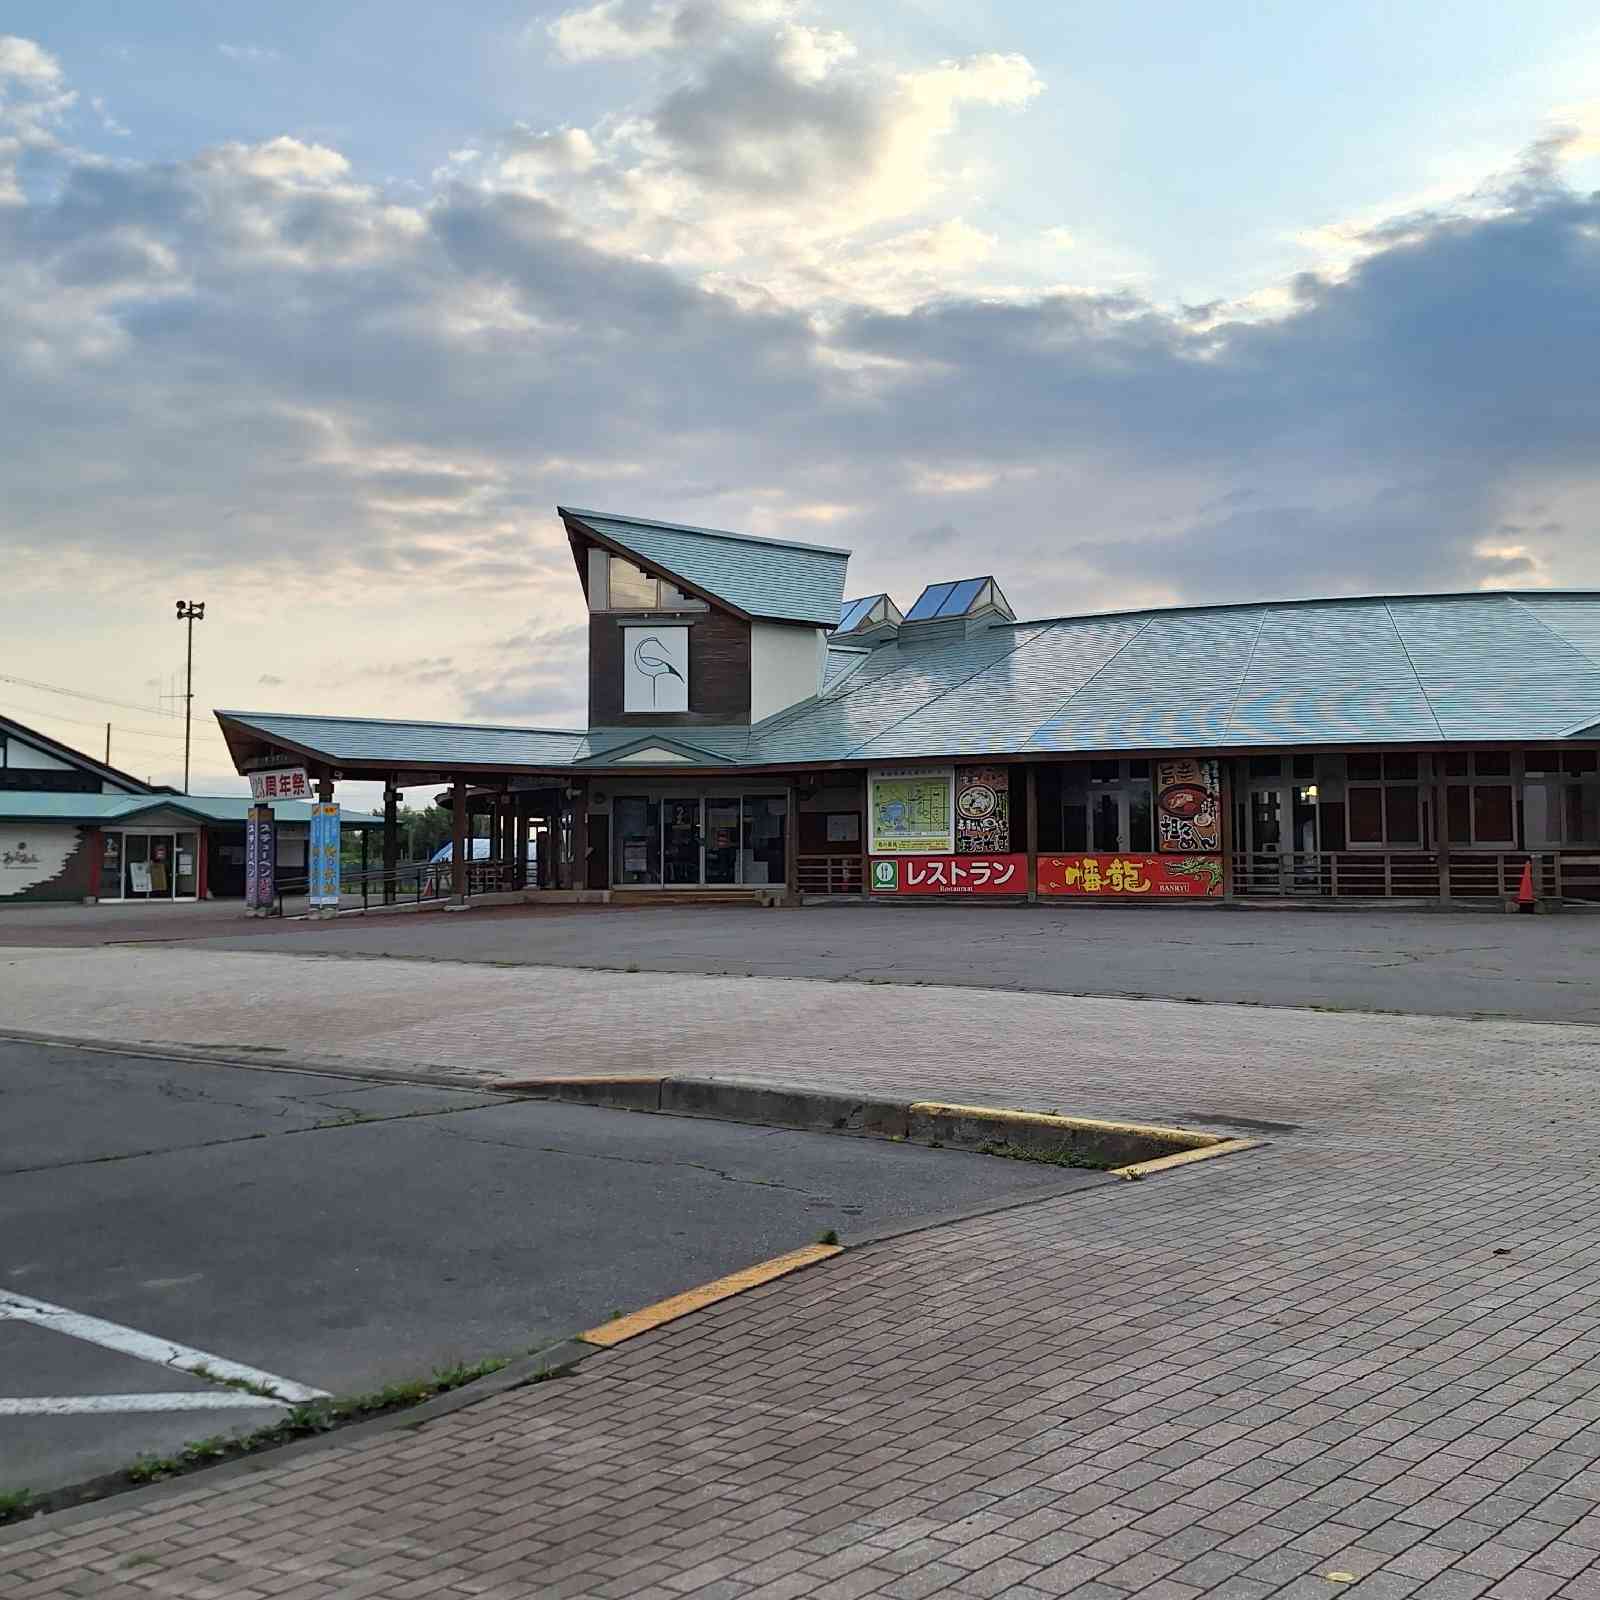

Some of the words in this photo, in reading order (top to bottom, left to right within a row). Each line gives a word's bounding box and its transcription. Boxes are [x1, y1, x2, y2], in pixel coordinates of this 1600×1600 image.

[907, 861, 1015, 885] レストラン
